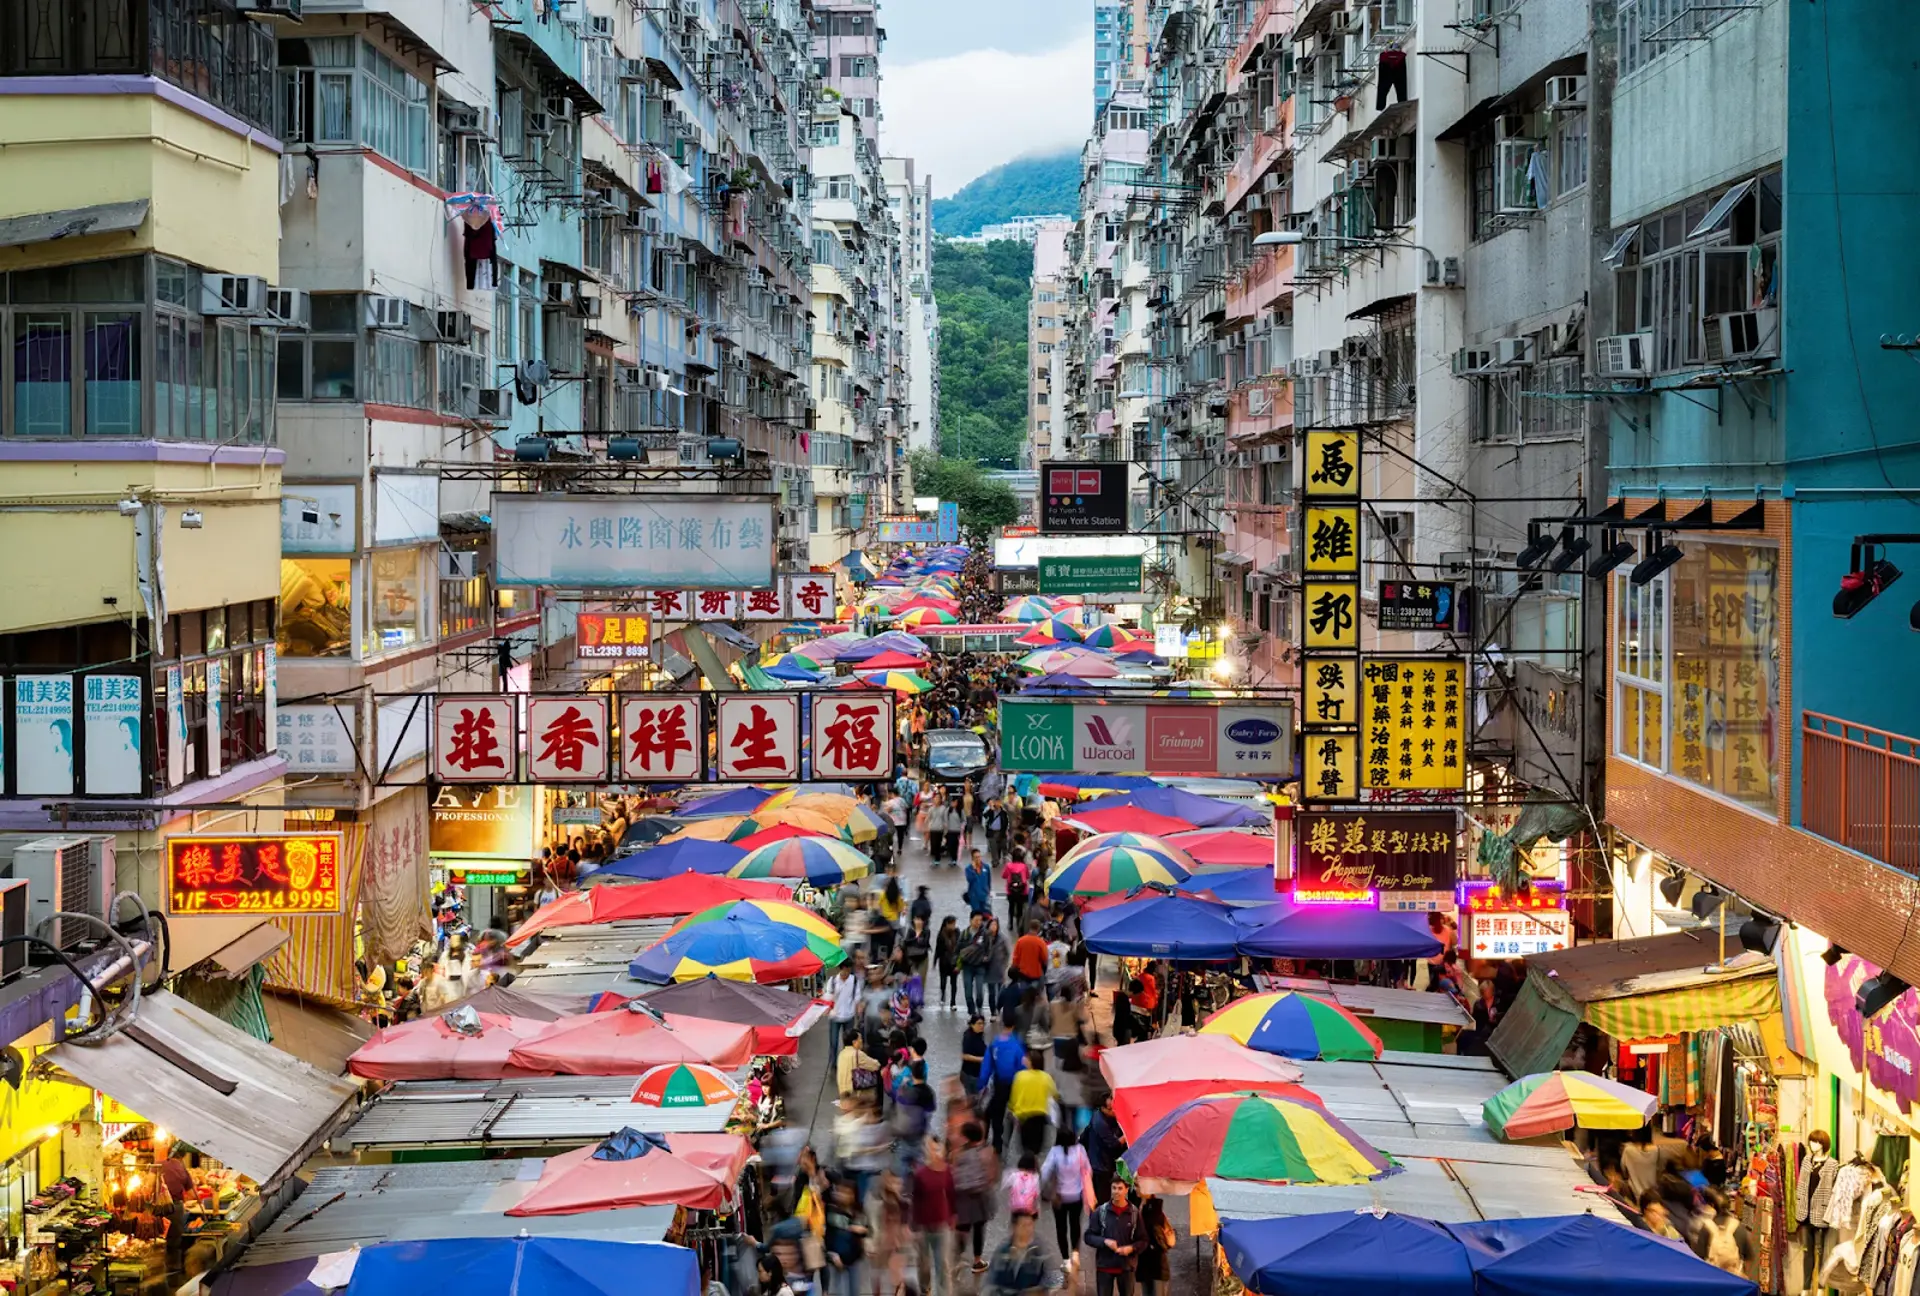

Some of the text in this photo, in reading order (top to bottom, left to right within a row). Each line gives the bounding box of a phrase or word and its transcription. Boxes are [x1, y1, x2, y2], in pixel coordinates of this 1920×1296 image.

[1049, 517, 1121, 525] New York Station
[18, 680, 71, 702] 雅美姿
[88, 678, 139, 700] 雅美姿
[16, 705, 71, 714] TEL:22149995
[1257, 728, 1278, 739] Form
[1011, 734, 1064, 761] LEONA
[1159, 734, 1204, 749] Triumph
[1083, 746, 1135, 761] Wacoal
[1235, 750, 1272, 761] 安莉芳
[435, 811, 516, 822] PROFESSIONAL
[1375, 873, 1434, 889] Hair Design
[174, 891, 335, 910] 1/F 2214 9995
